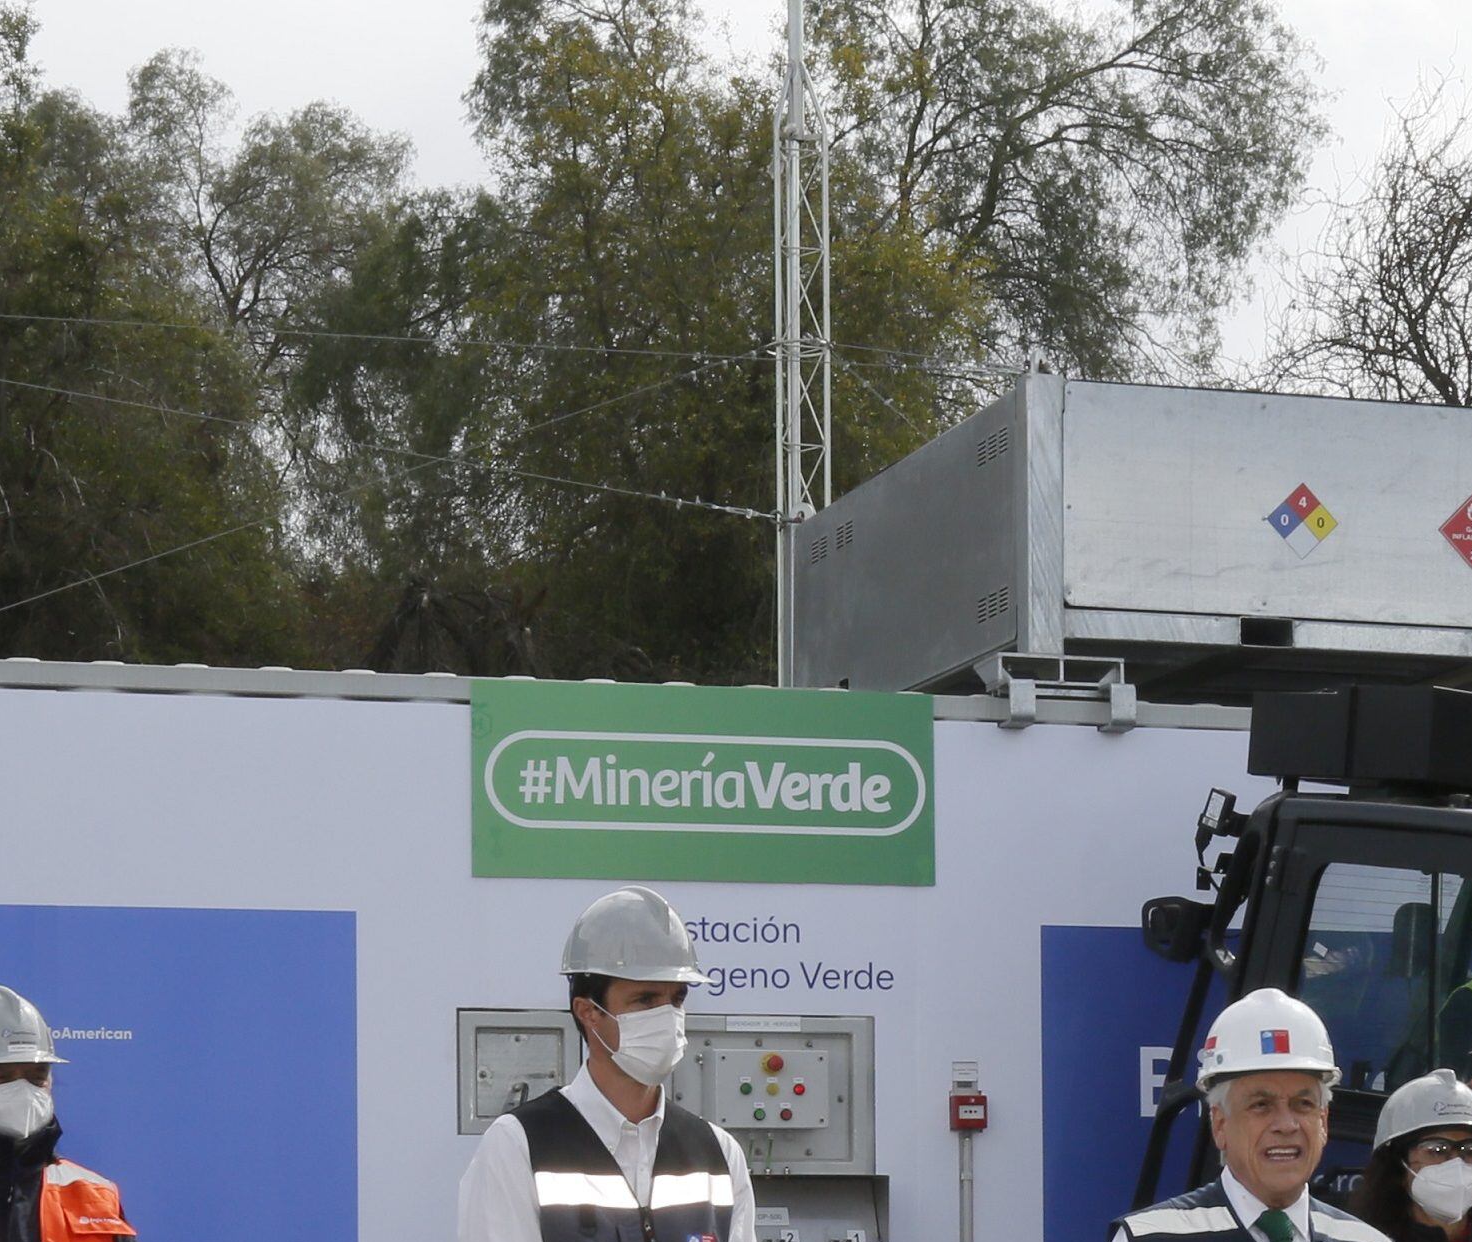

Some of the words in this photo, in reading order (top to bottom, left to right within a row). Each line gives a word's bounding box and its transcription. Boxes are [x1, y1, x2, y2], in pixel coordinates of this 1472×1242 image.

[1298, 496, 1307, 508] 4
[1280, 513, 1289, 526] 0
[1317, 516, 1325, 528] 0
[519, 751, 892, 814] #MineríaVerde
[684, 915, 800, 943] stación
[687, 966, 790, 997] geno
[800, 961, 894, 990] Verde
